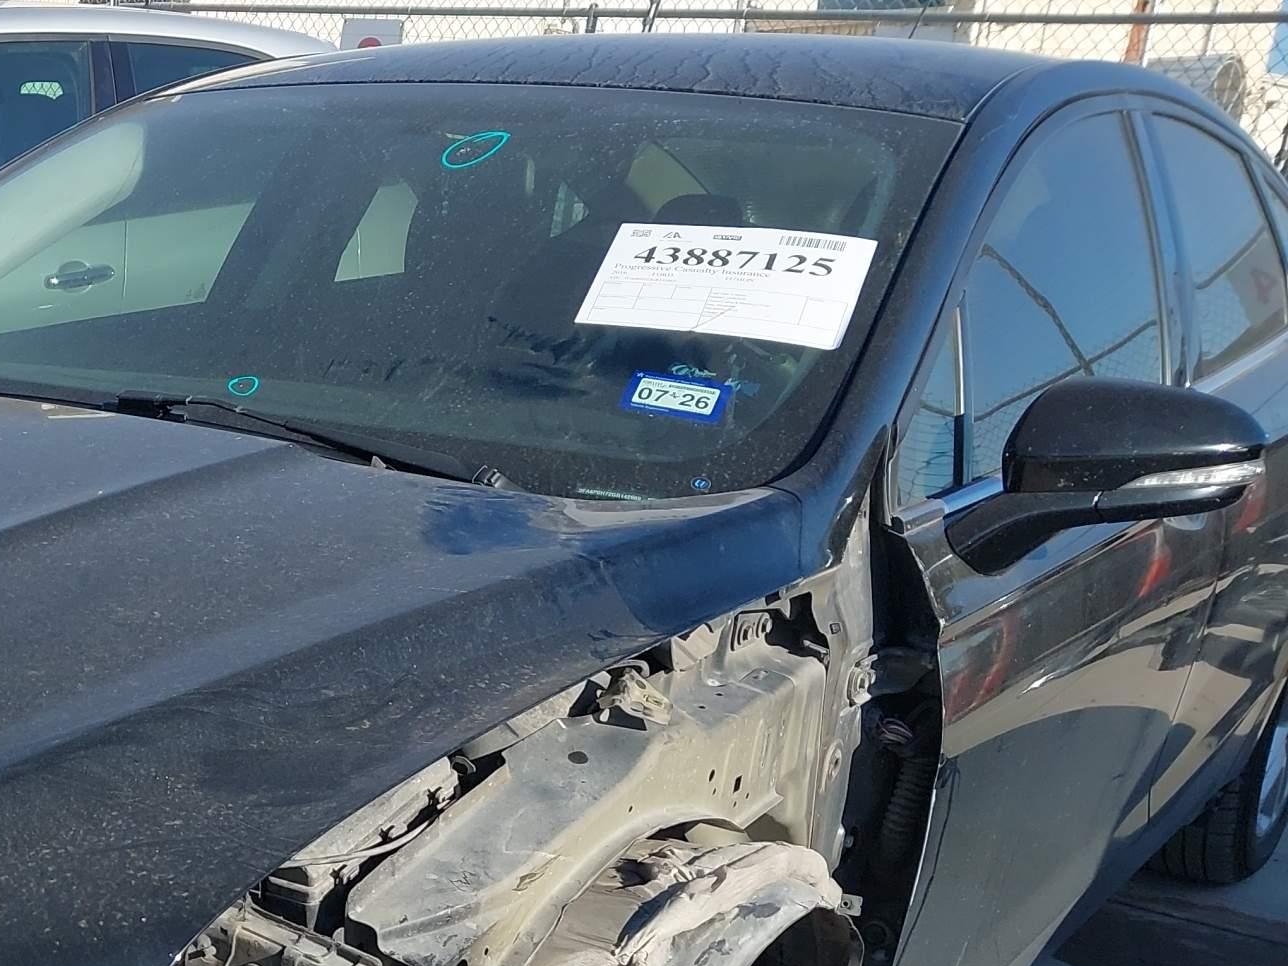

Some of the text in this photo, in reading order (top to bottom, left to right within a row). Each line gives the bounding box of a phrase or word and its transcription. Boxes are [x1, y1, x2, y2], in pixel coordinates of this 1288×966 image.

[614, 263, 672, 273] Progressive
[721, 269, 770, 278] Insurance
[634, 246, 836, 276] 43887125
[638, 387, 669, 402] 07
[678, 393, 711, 410] 26
